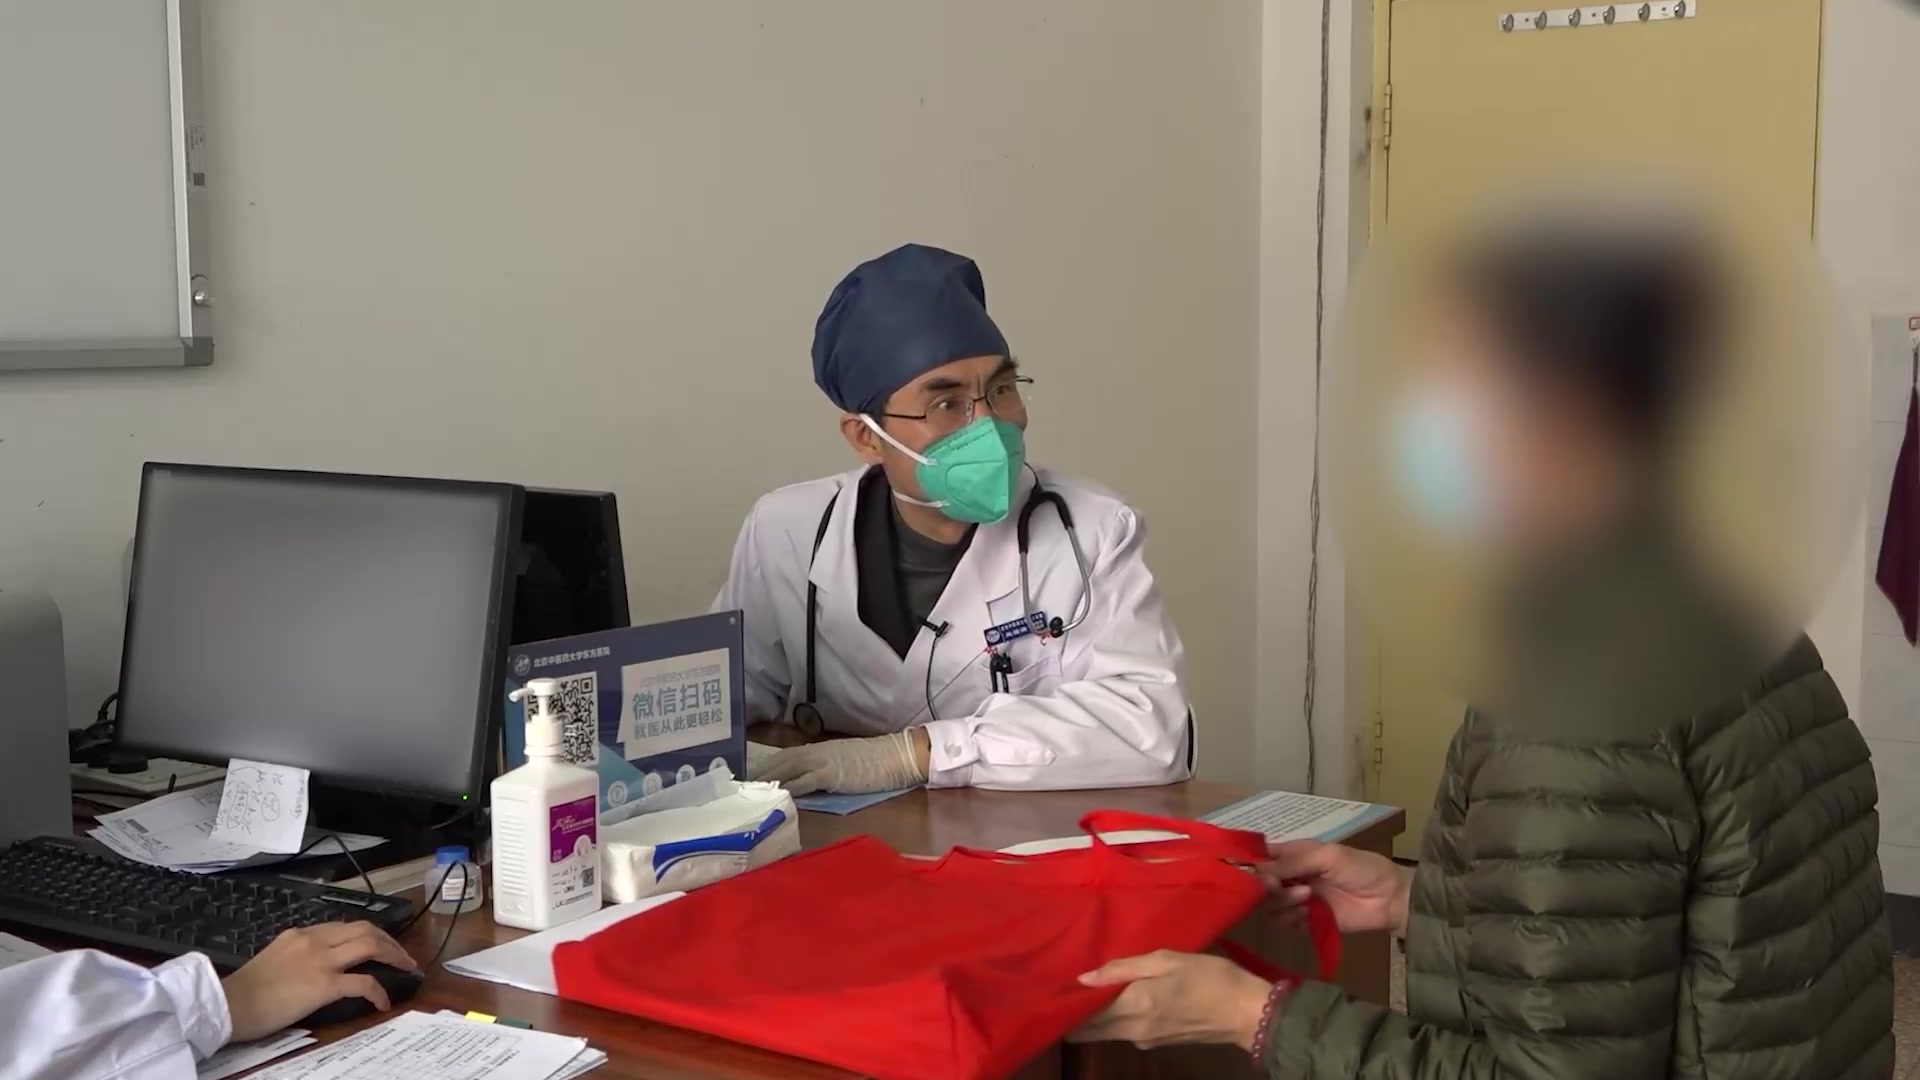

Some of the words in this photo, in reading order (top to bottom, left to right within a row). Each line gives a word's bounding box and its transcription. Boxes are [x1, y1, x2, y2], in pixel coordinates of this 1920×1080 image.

[534, 646, 610, 668] 北京中医药大学东方医院
[633, 678, 721, 720] 微信扫码
[635, 708, 723, 741] 就医从此更轻松
